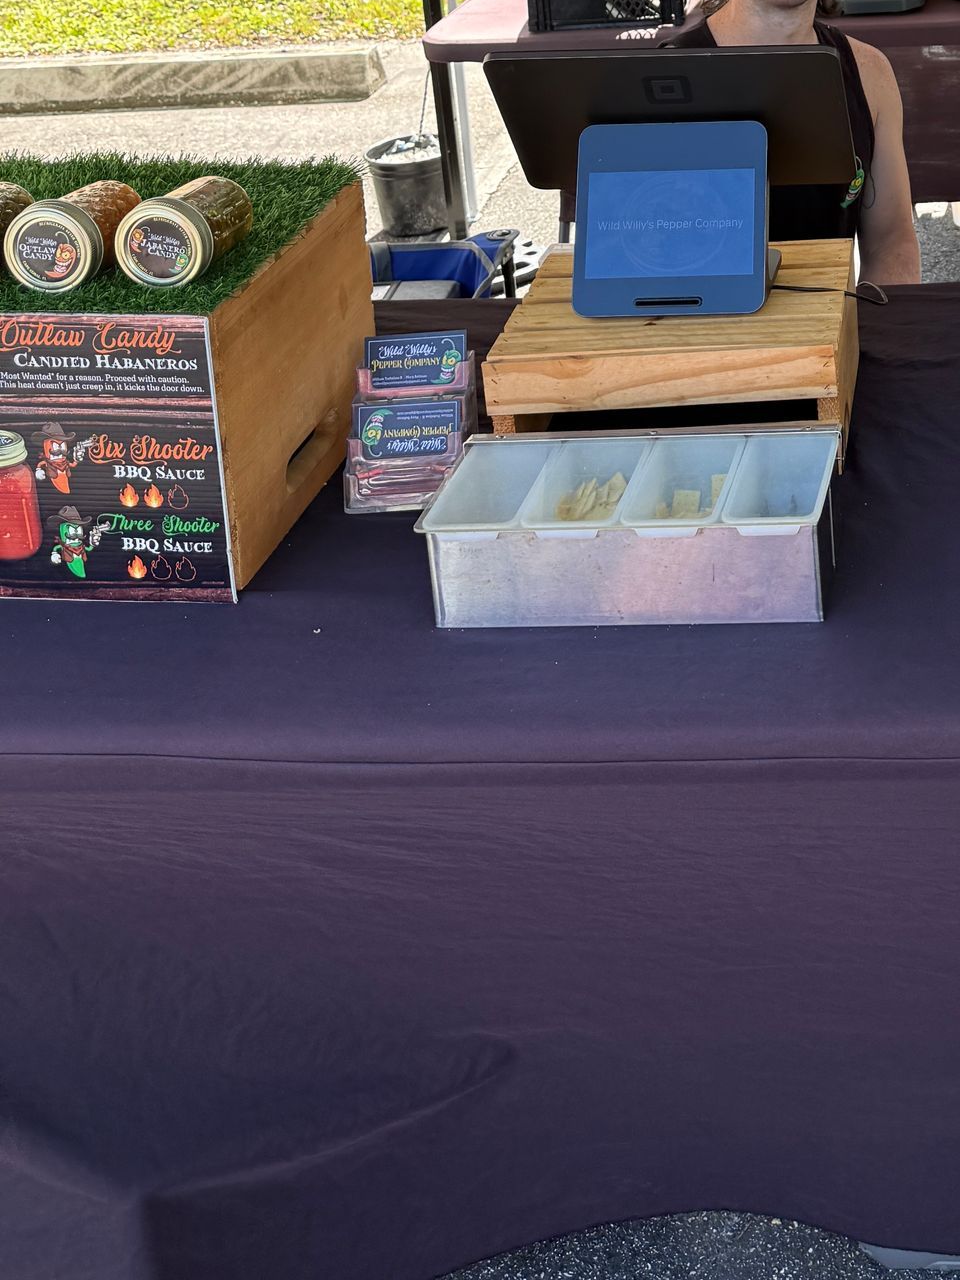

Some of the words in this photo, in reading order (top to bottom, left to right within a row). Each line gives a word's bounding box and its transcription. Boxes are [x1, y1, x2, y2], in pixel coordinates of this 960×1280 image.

[598, 220, 620, 231] Wild
[622, 220, 654, 231] Willy's
[656, 219, 692, 230] Pepper
[695, 218, 744, 230] Company
[19, 243, 57, 254] OUTLAW
[140, 239, 186, 254] JABANERO
[147, 248, 178, 260] CANDY
[23, 250, 53, 261] CANDY
[0, 319, 86, 353] Outlaw
[93, 322, 182, 356] Candy
[378, 344, 404, 359] Wild
[404, 342, 437, 357] Willy's
[13, 352, 91, 369] CANDIED
[95, 355, 198, 371] HABANEROS
[371, 359, 403, 373] PEPPER
[403, 356, 440, 370] COMPANY
[56, 372, 67, 381] for
[105, 374, 136, 382] Proceed
[157, 376, 190, 384] caution.
[17, 381, 35, 389] heat
[36, 381, 64, 389] doesn't
[65, 382, 80, 391] just
[105, 383, 115, 391] in,
[116, 383, 123, 391] it
[124, 383, 146, 391] kicks
[161, 384, 179, 392] door
[180, 385, 205, 393] down.
[382, 425, 421, 439] COMPANY
[422, 423, 454, 436] PEPPER
[88, 433, 126, 465] Six
[130, 434, 213, 465] Shooter
[420, 436, 447, 451] Wild
[112, 464, 153, 482] BBQ
[155, 465, 205, 480] SAUCE
[97, 513, 155, 535] Three
[162, 514, 220, 536] Shooter
[121, 537, 161, 554] BBQ
[163, 537, 213, 553] SAUCE
